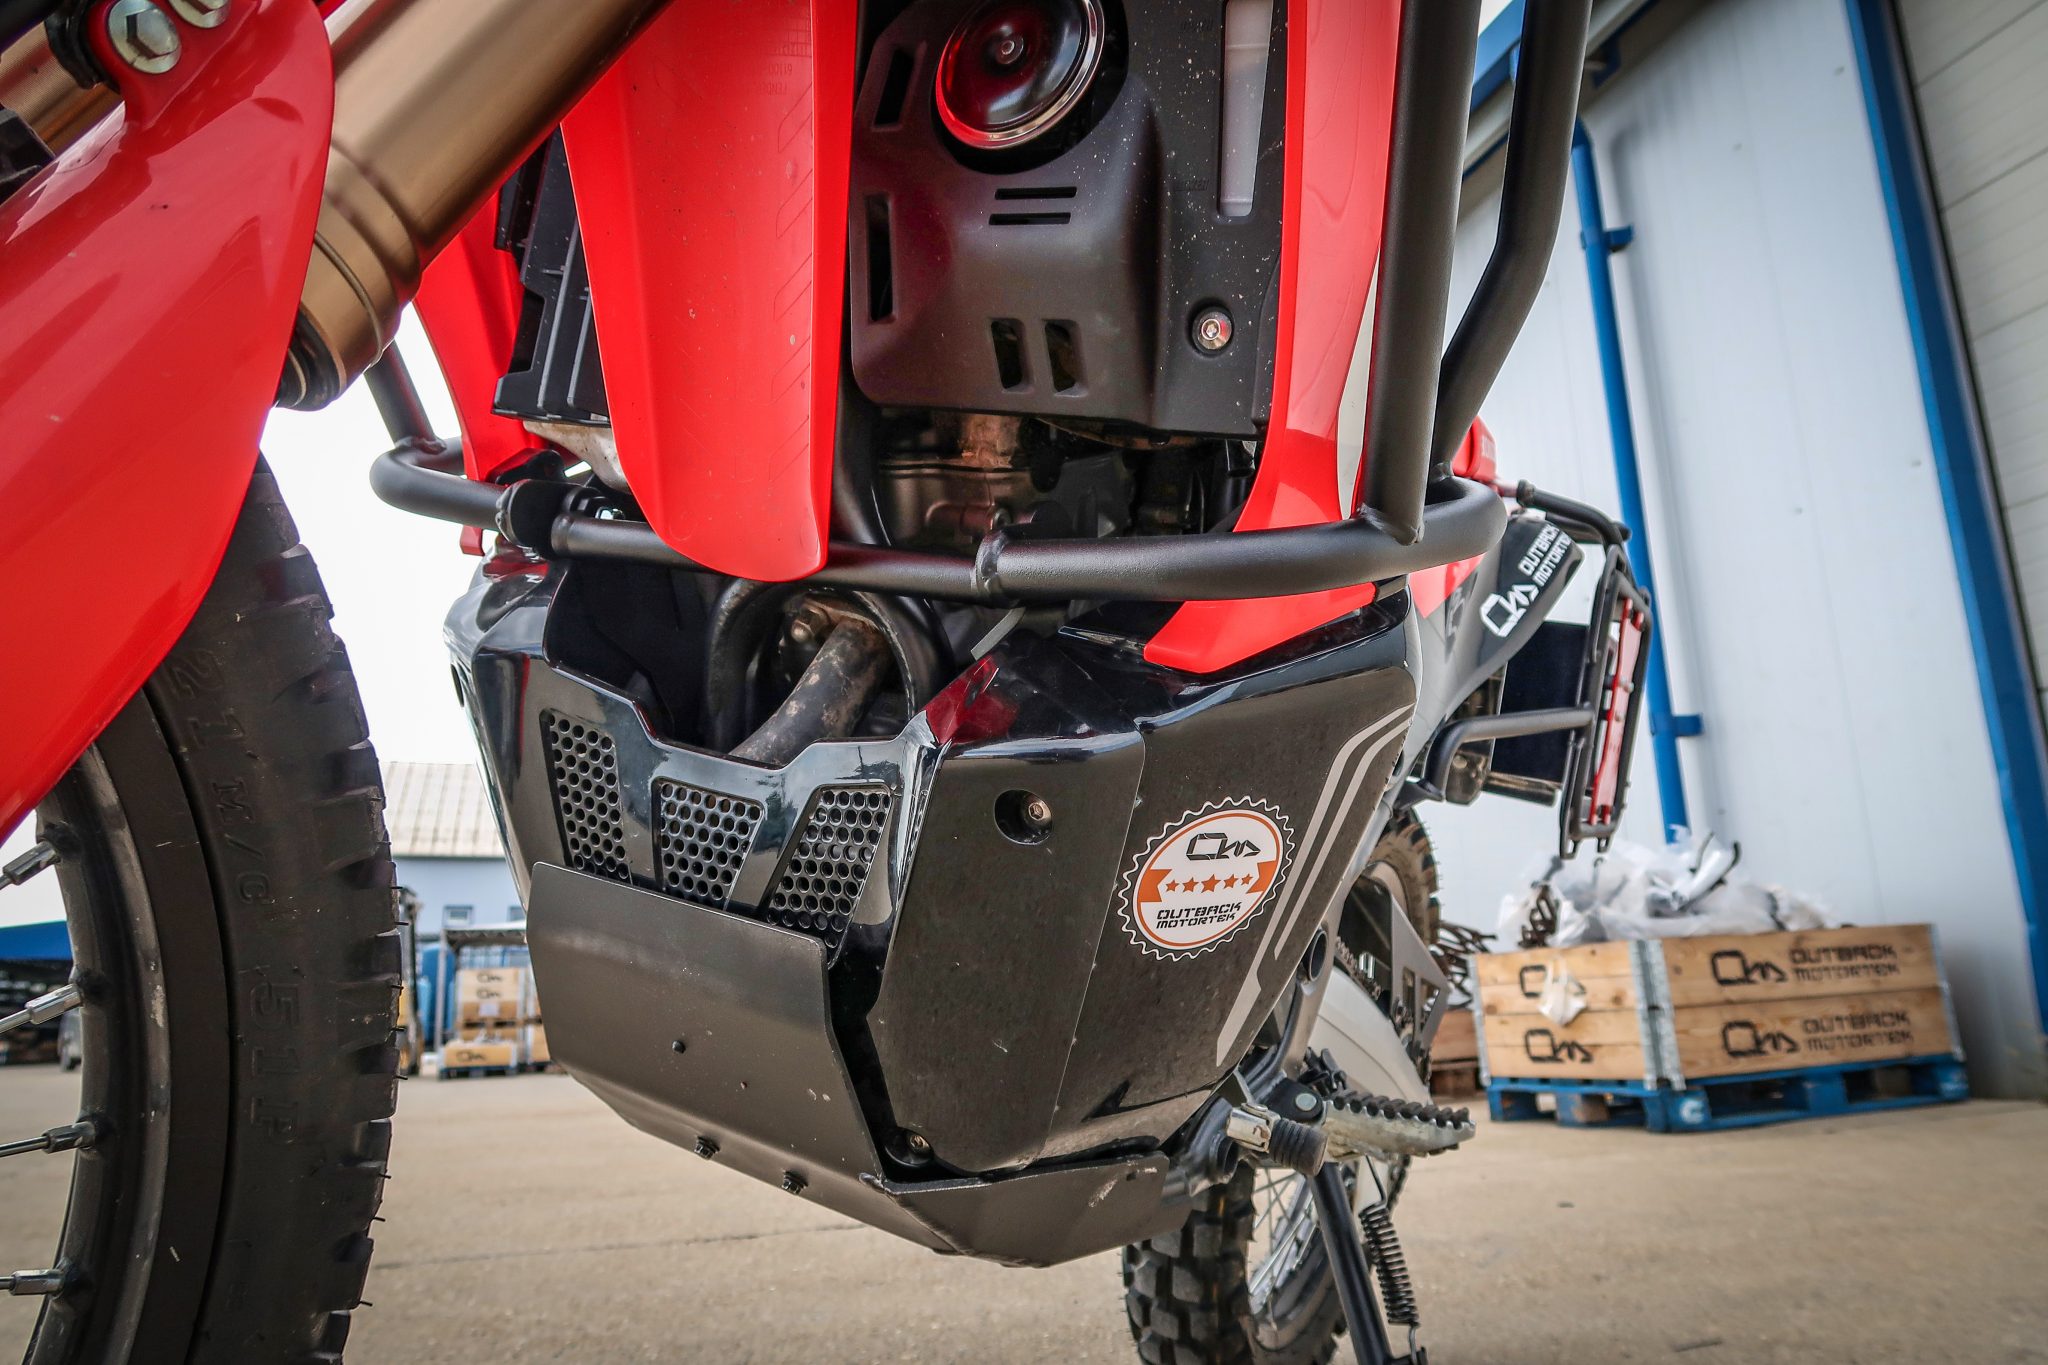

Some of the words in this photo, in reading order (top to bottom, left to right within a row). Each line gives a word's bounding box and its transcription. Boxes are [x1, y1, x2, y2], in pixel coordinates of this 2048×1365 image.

[1518, 524, 1560, 577] OUTBACK
[1156, 902, 1243, 920] OUTBACK
[1156, 913, 1236, 929] MOTORTEK
[1790, 943, 1898, 965] OUTBACK
[1793, 962, 1900, 982] MOTORTEK
[1803, 1011, 1911, 1035] OUTBACK
[1807, 1030, 1914, 1052] MOTORTEK
